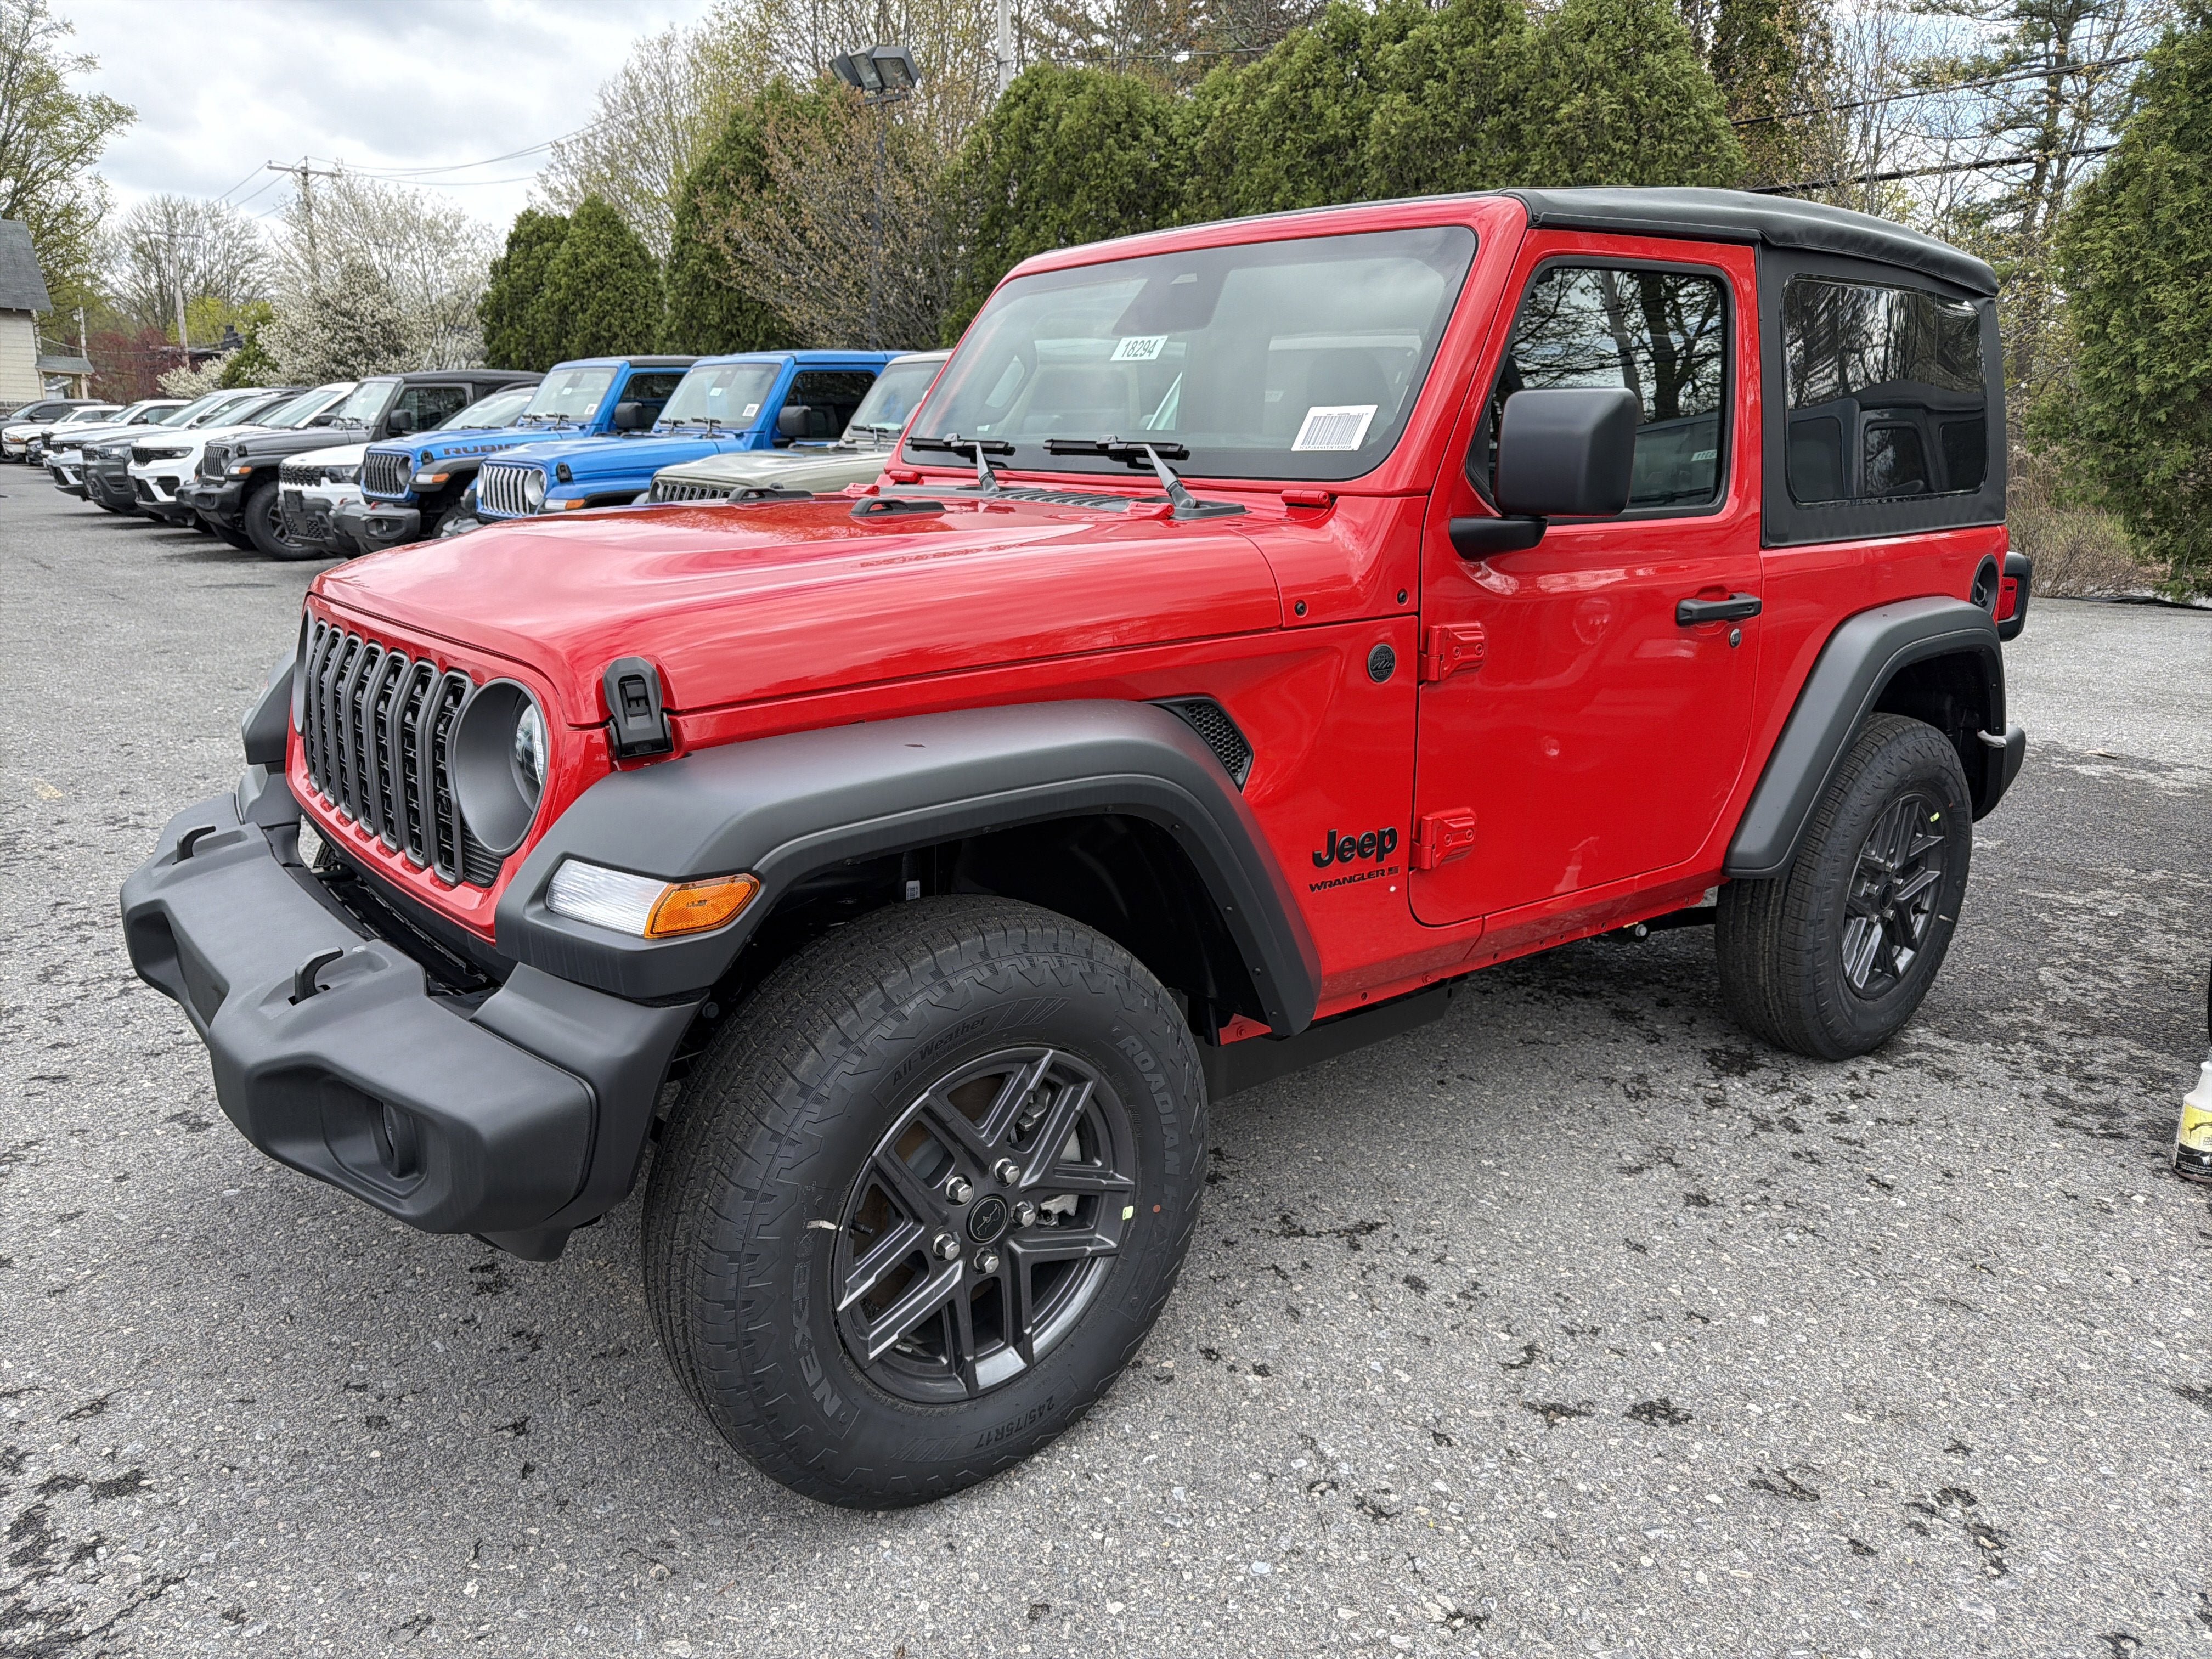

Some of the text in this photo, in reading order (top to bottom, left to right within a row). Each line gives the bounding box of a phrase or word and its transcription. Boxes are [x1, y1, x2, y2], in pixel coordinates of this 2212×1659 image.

[1121, 338, 1159, 357] 18294
[444, 444, 511, 455] RUBI
[1312, 826, 1398, 868] Jeep
[1308, 868, 1386, 893] WRANGLER
[893, 1015, 988, 1086] All-Weather
[1116, 1035, 1180, 1175] ROADIAN
[974, 1395, 1054, 1449] 245/75R17
